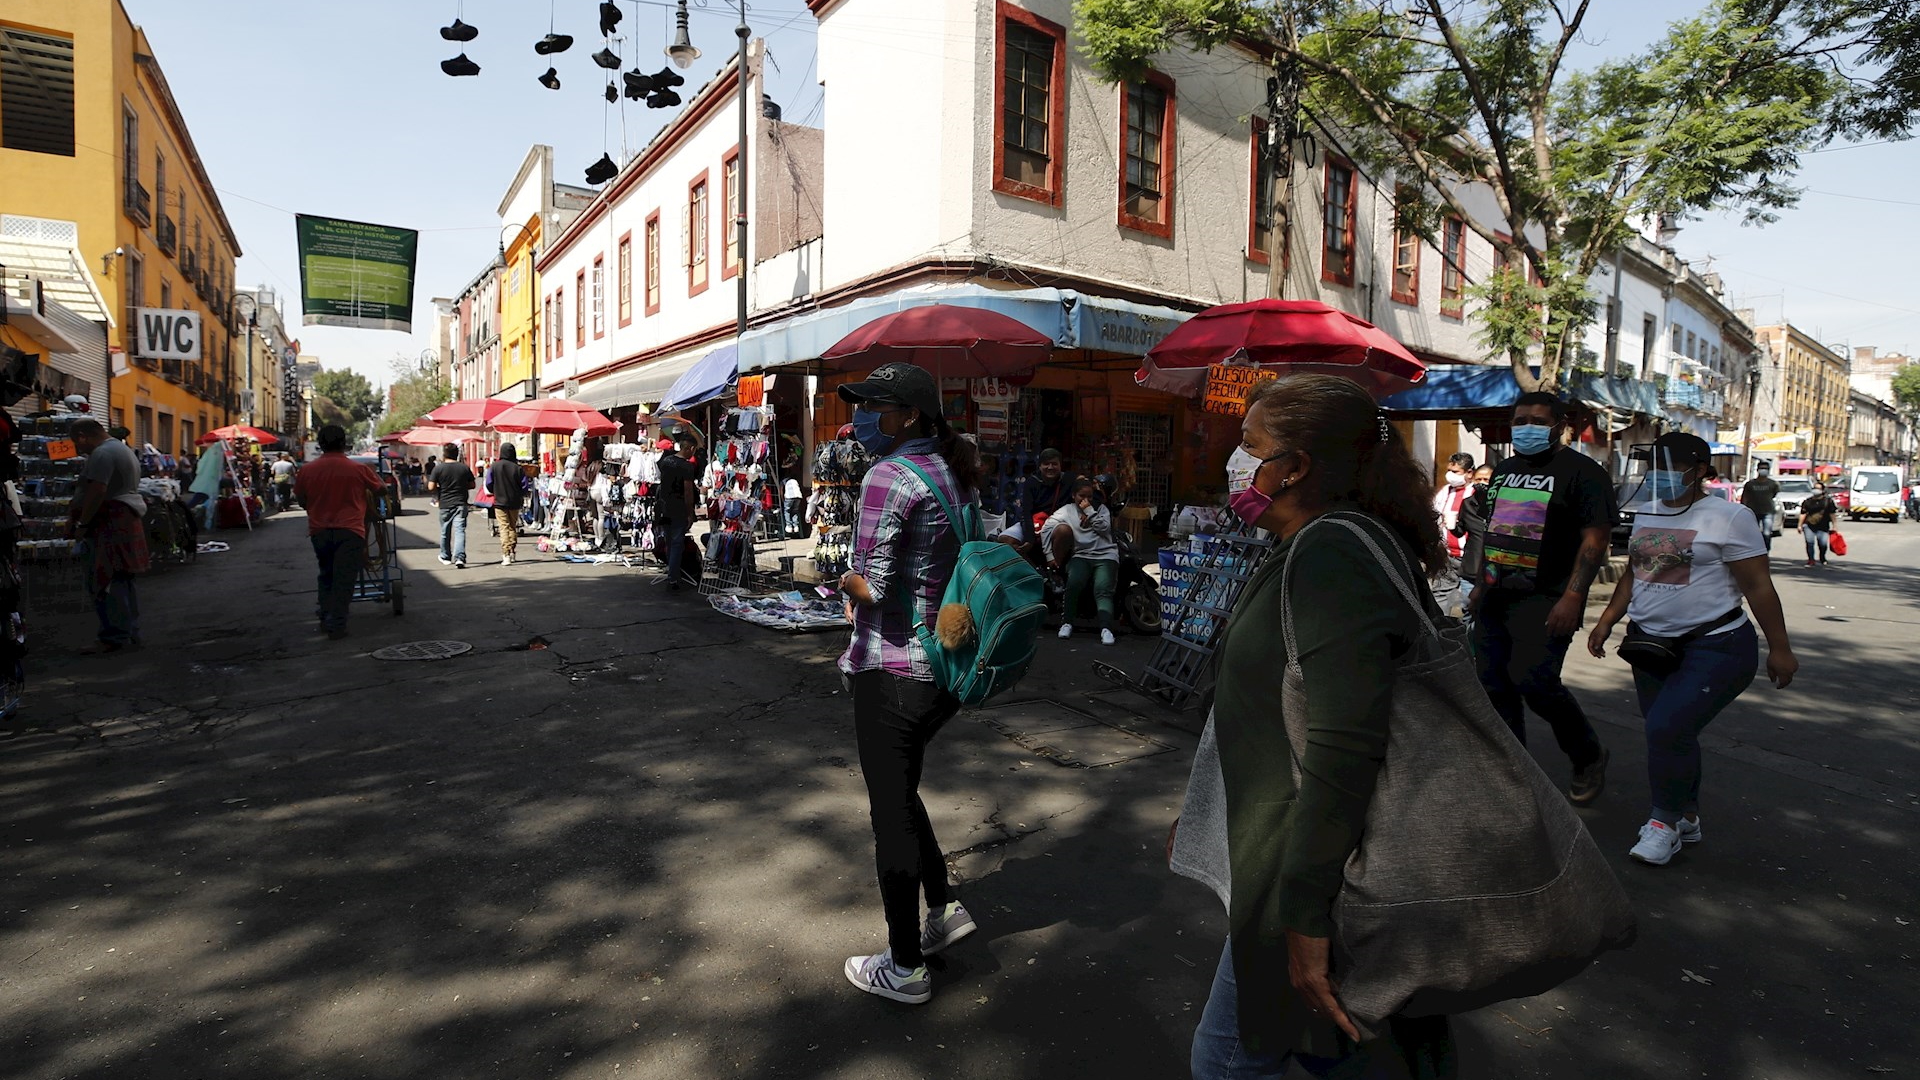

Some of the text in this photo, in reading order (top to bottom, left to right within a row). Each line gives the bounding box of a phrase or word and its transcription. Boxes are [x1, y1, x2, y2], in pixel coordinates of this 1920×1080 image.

[328, 220, 386, 233] SANA DISTANCIA
[335, 228, 363, 236] CENTRO
[144, 313, 193, 353] WC
[1503, 472, 1556, 492] NASA
